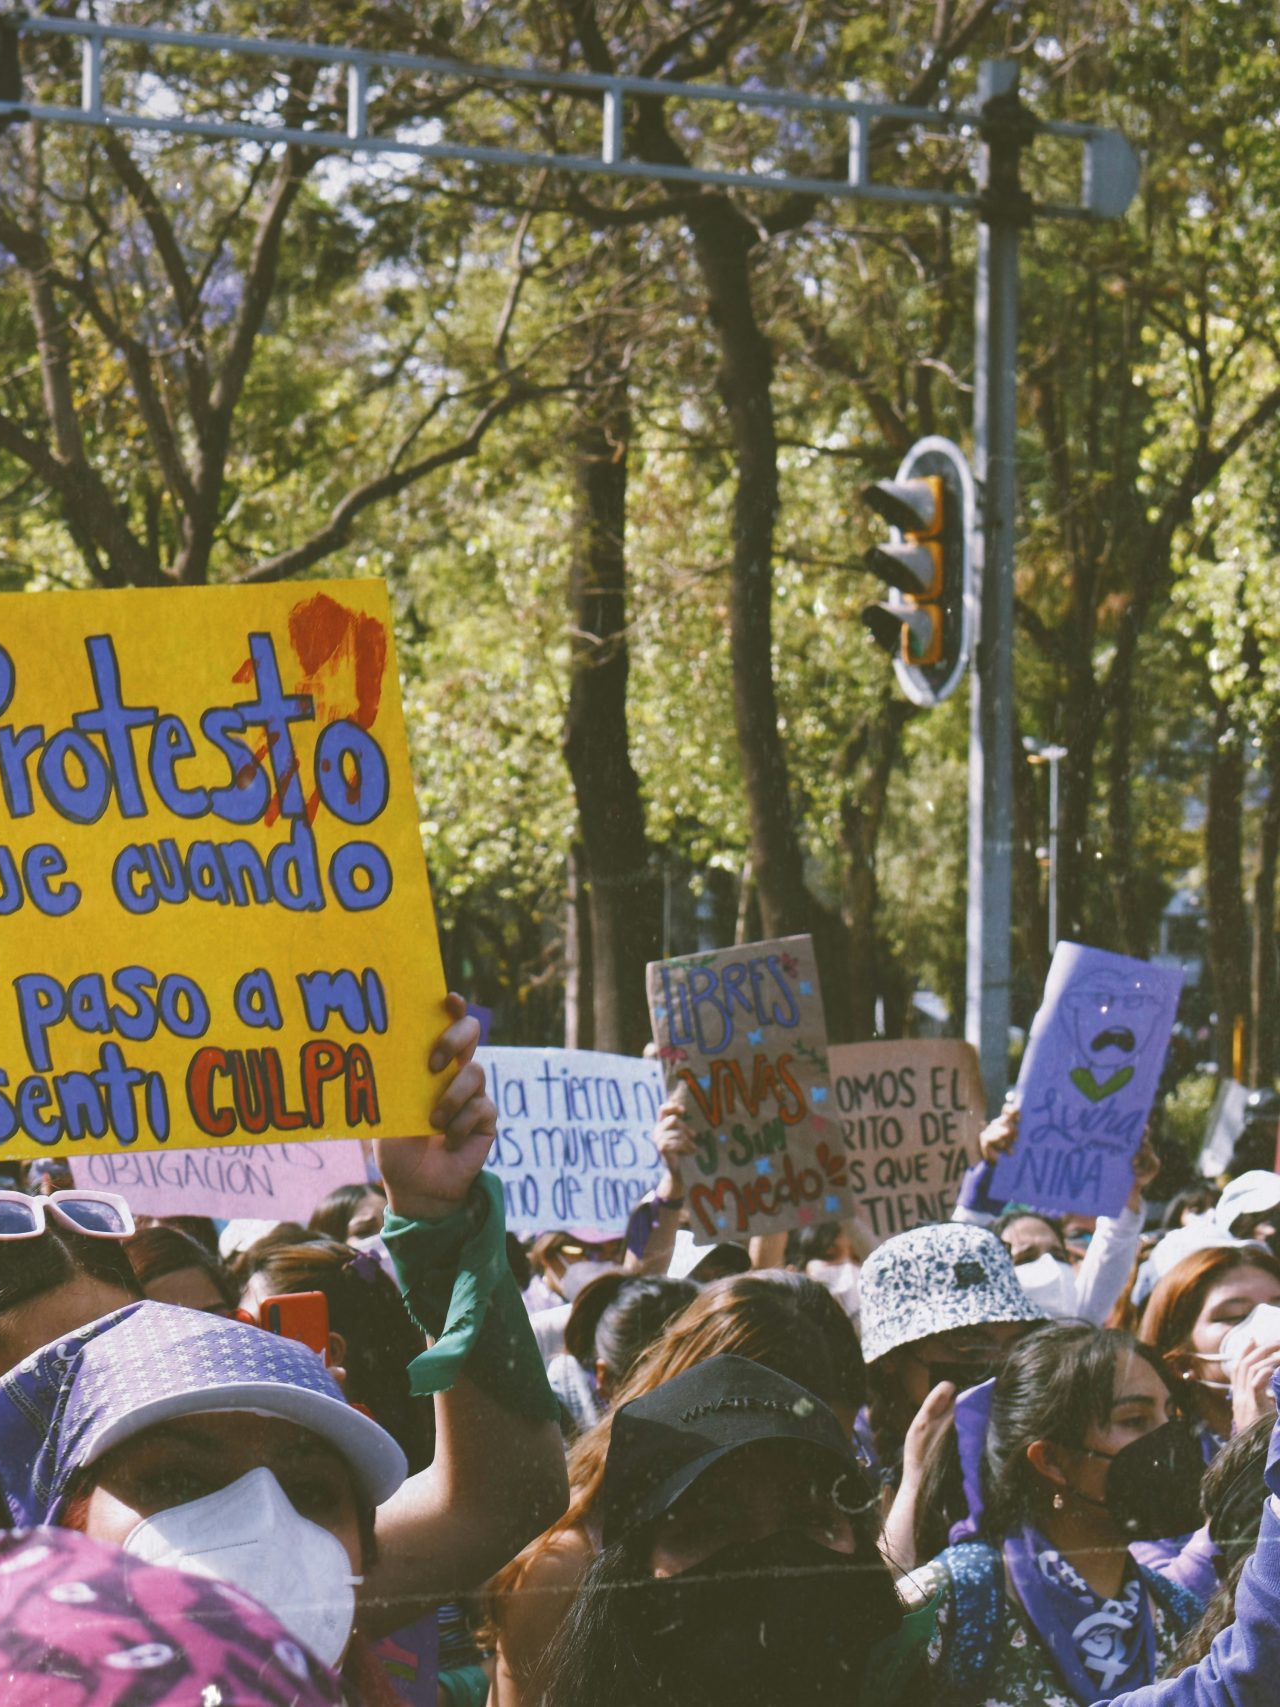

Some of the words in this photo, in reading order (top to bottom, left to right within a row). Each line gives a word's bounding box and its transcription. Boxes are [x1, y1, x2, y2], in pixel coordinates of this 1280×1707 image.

[113, 818, 393, 914] cuando
[14, 965, 212, 1071] paso
[233, 967, 284, 1030] a
[296, 967, 389, 1034] mi
[660, 953, 801, 1055] LIBRES
[185, 1040, 382, 1136] CULPA
[490, 1062, 529, 1119] la
[537, 1060, 628, 1121] tierra
[633, 1072, 663, 1122] ni
[676, 1053, 808, 1129] VIVAS
[835, 1067, 917, 1113] OMOS
[930, 1066, 968, 1112] EL
[1027, 1087, 1146, 1147] Lucha
[531, 1125, 638, 1174] mujeres
[841, 1114, 905, 1152] RITO
[920, 1111, 959, 1147] DE
[87, 1153, 276, 1198] OBLIGACION
[552, 1167, 583, 1221] de
[873, 1153, 930, 1190] QUE
[939, 1146, 970, 1184] YA
[1011, 1143, 1104, 1204] NIÑA
